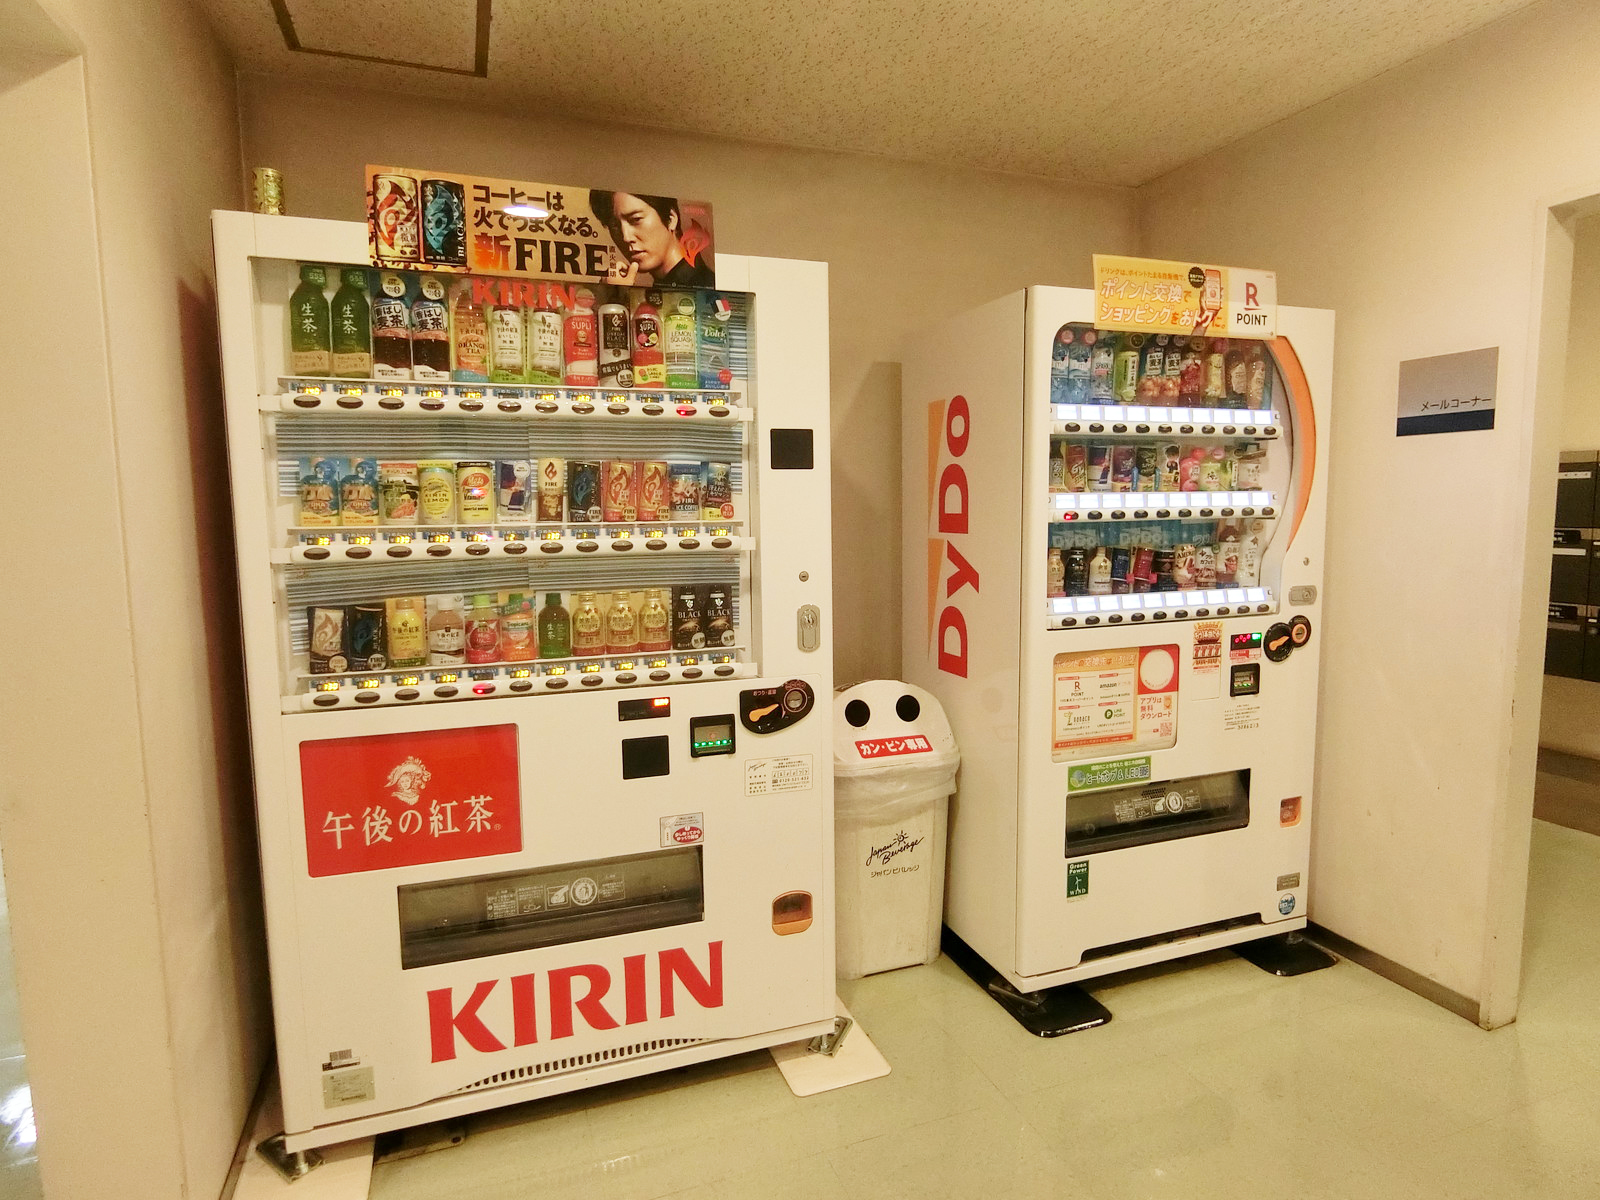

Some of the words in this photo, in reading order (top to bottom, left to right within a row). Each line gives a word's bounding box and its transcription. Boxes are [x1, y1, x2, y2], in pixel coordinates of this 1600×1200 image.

[473, 184, 565, 212] コーヒーは
[472, 277, 576, 311] KIRIN
[1245, 282, 1259, 307] R
[571, 321, 592, 330] SUPLI
[640, 323, 657, 331] SUPLI
[1236, 312, 1268, 326] POINT
[1420, 395, 1493, 412] メールコーナー
[677, 610, 701, 619] BLACK
[707, 609, 731, 617] BLACK
[860, 738, 929, 756] カン・ビン専用
[322, 795, 494, 850] 午後の紅茶
[426, 940, 723, 1063] KIRIN
